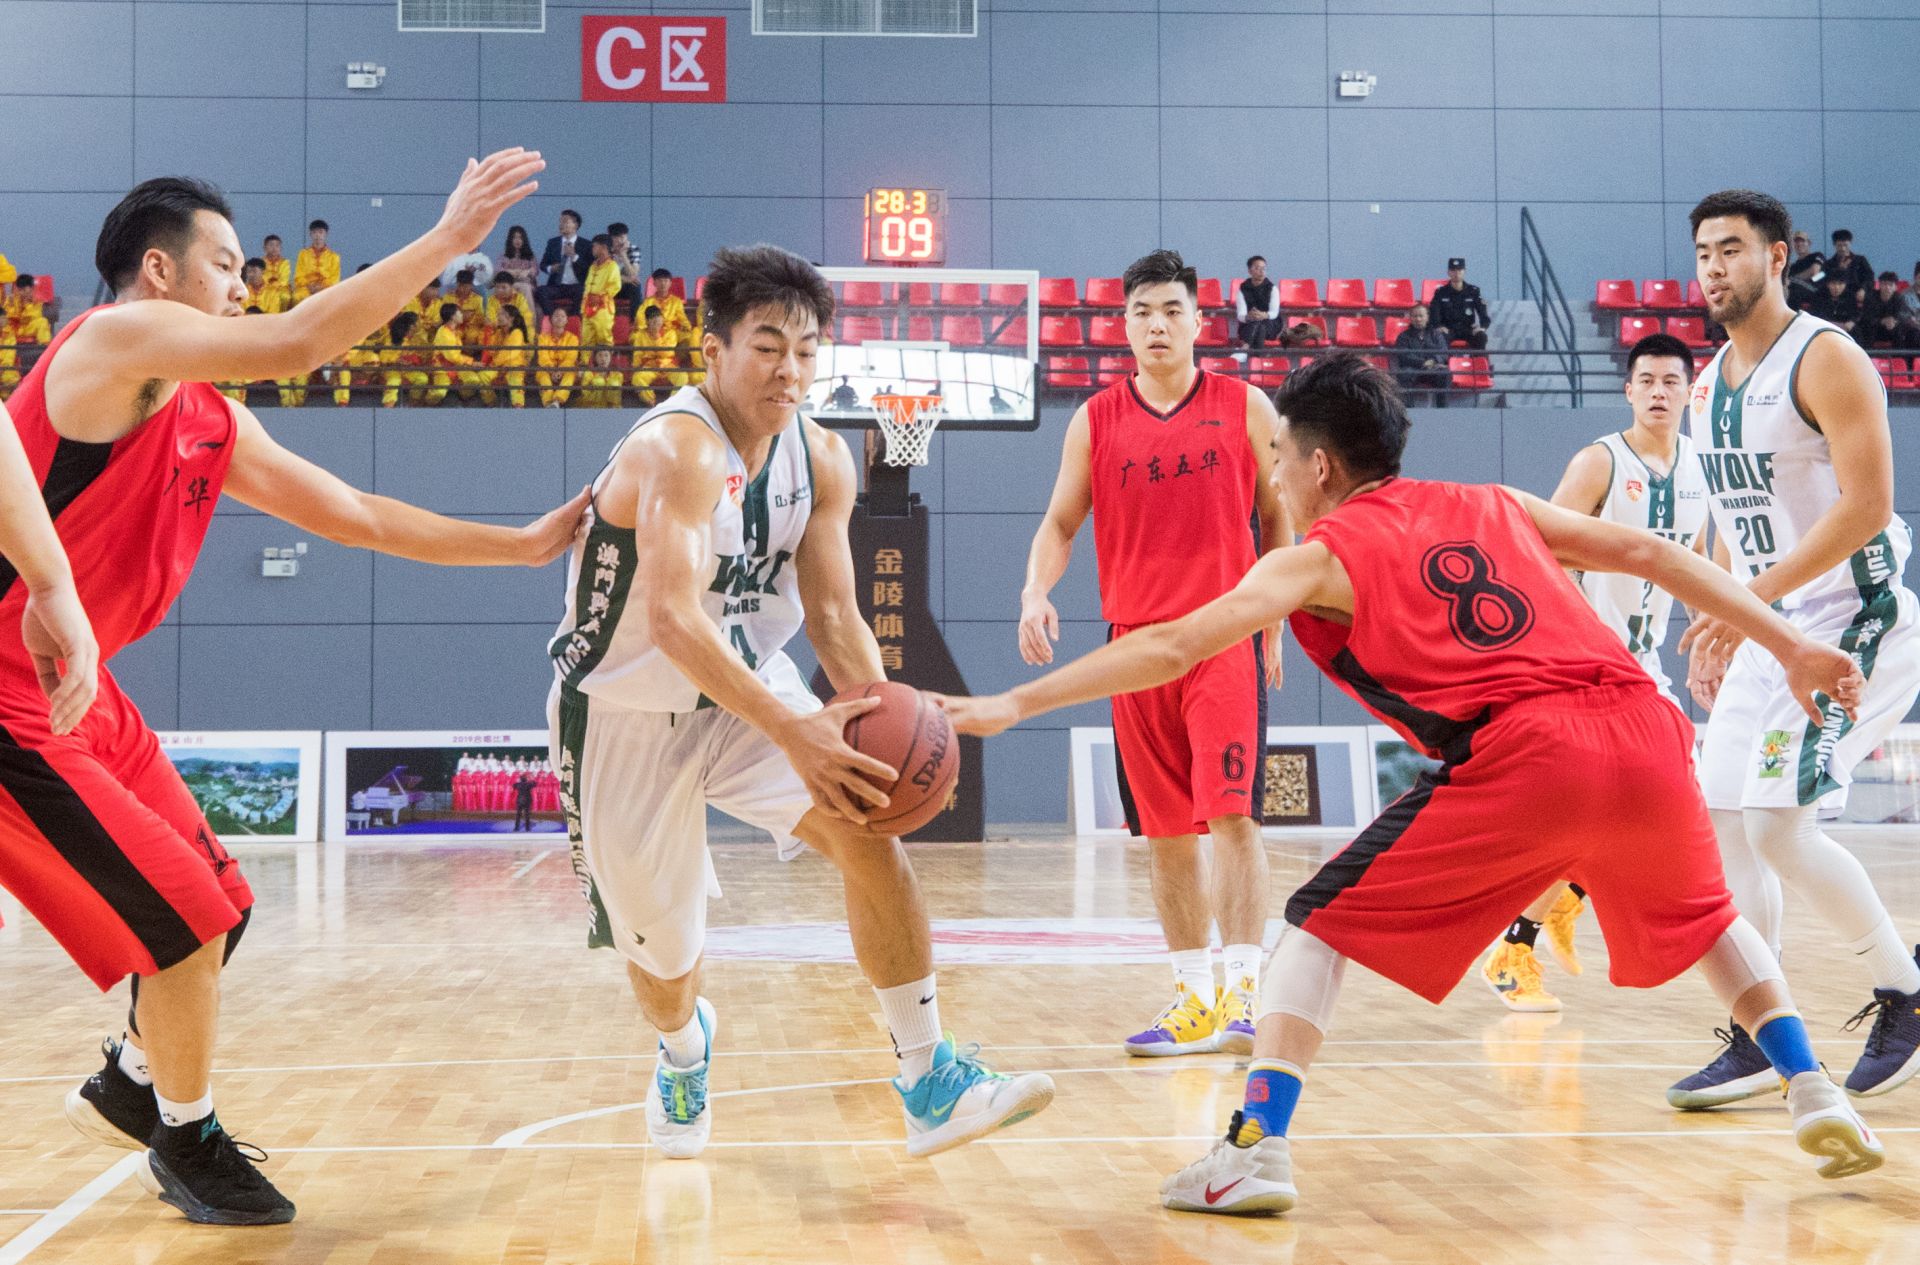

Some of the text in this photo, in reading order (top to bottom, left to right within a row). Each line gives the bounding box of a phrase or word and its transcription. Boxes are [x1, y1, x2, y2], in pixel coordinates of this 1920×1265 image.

[874, 190, 926, 214] 28.3
[881, 217, 932, 257] 09
[1121, 449, 1220, 488] 广东五华
[1697, 452, 1776, 496] WOLF
[1720, 496, 1772, 510] WARRIORS
[1735, 514, 1776, 556] 20
[872, 548, 904, 671] 金陵体育
[1421, 540, 1536, 653] 8
[722, 624, 757, 671] 4
[1222, 742, 1246, 781] 6
